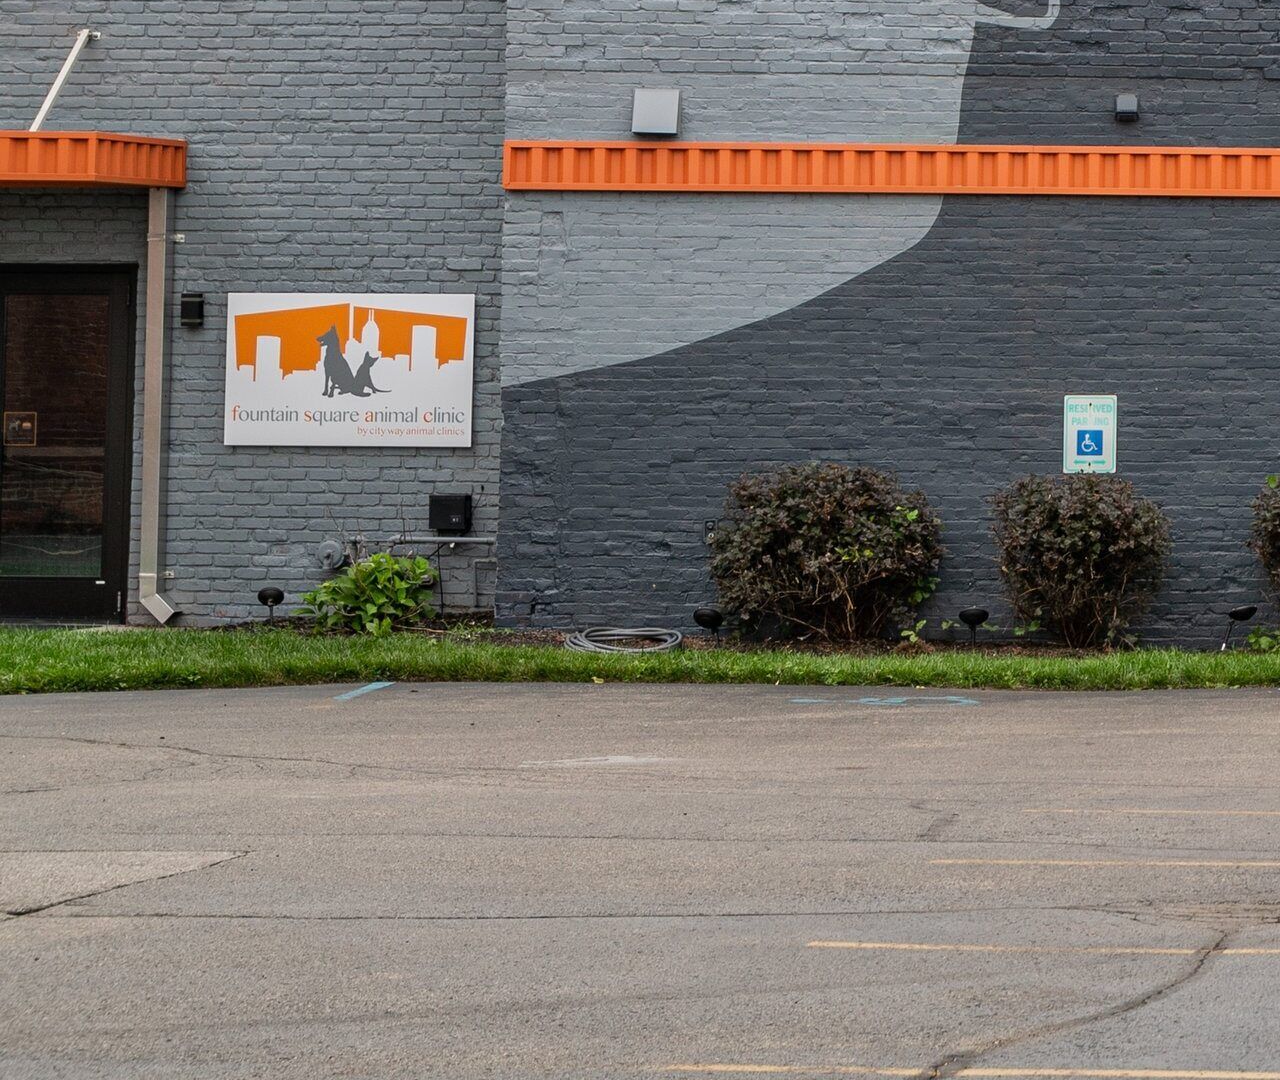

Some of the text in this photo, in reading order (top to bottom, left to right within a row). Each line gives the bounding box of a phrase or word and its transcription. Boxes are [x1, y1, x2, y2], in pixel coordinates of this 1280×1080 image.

[231, 405, 465, 426] fountain square animal clinic
[1072, 417, 1109, 426] PARING
[357, 426, 465, 437] by city way animal clinics
